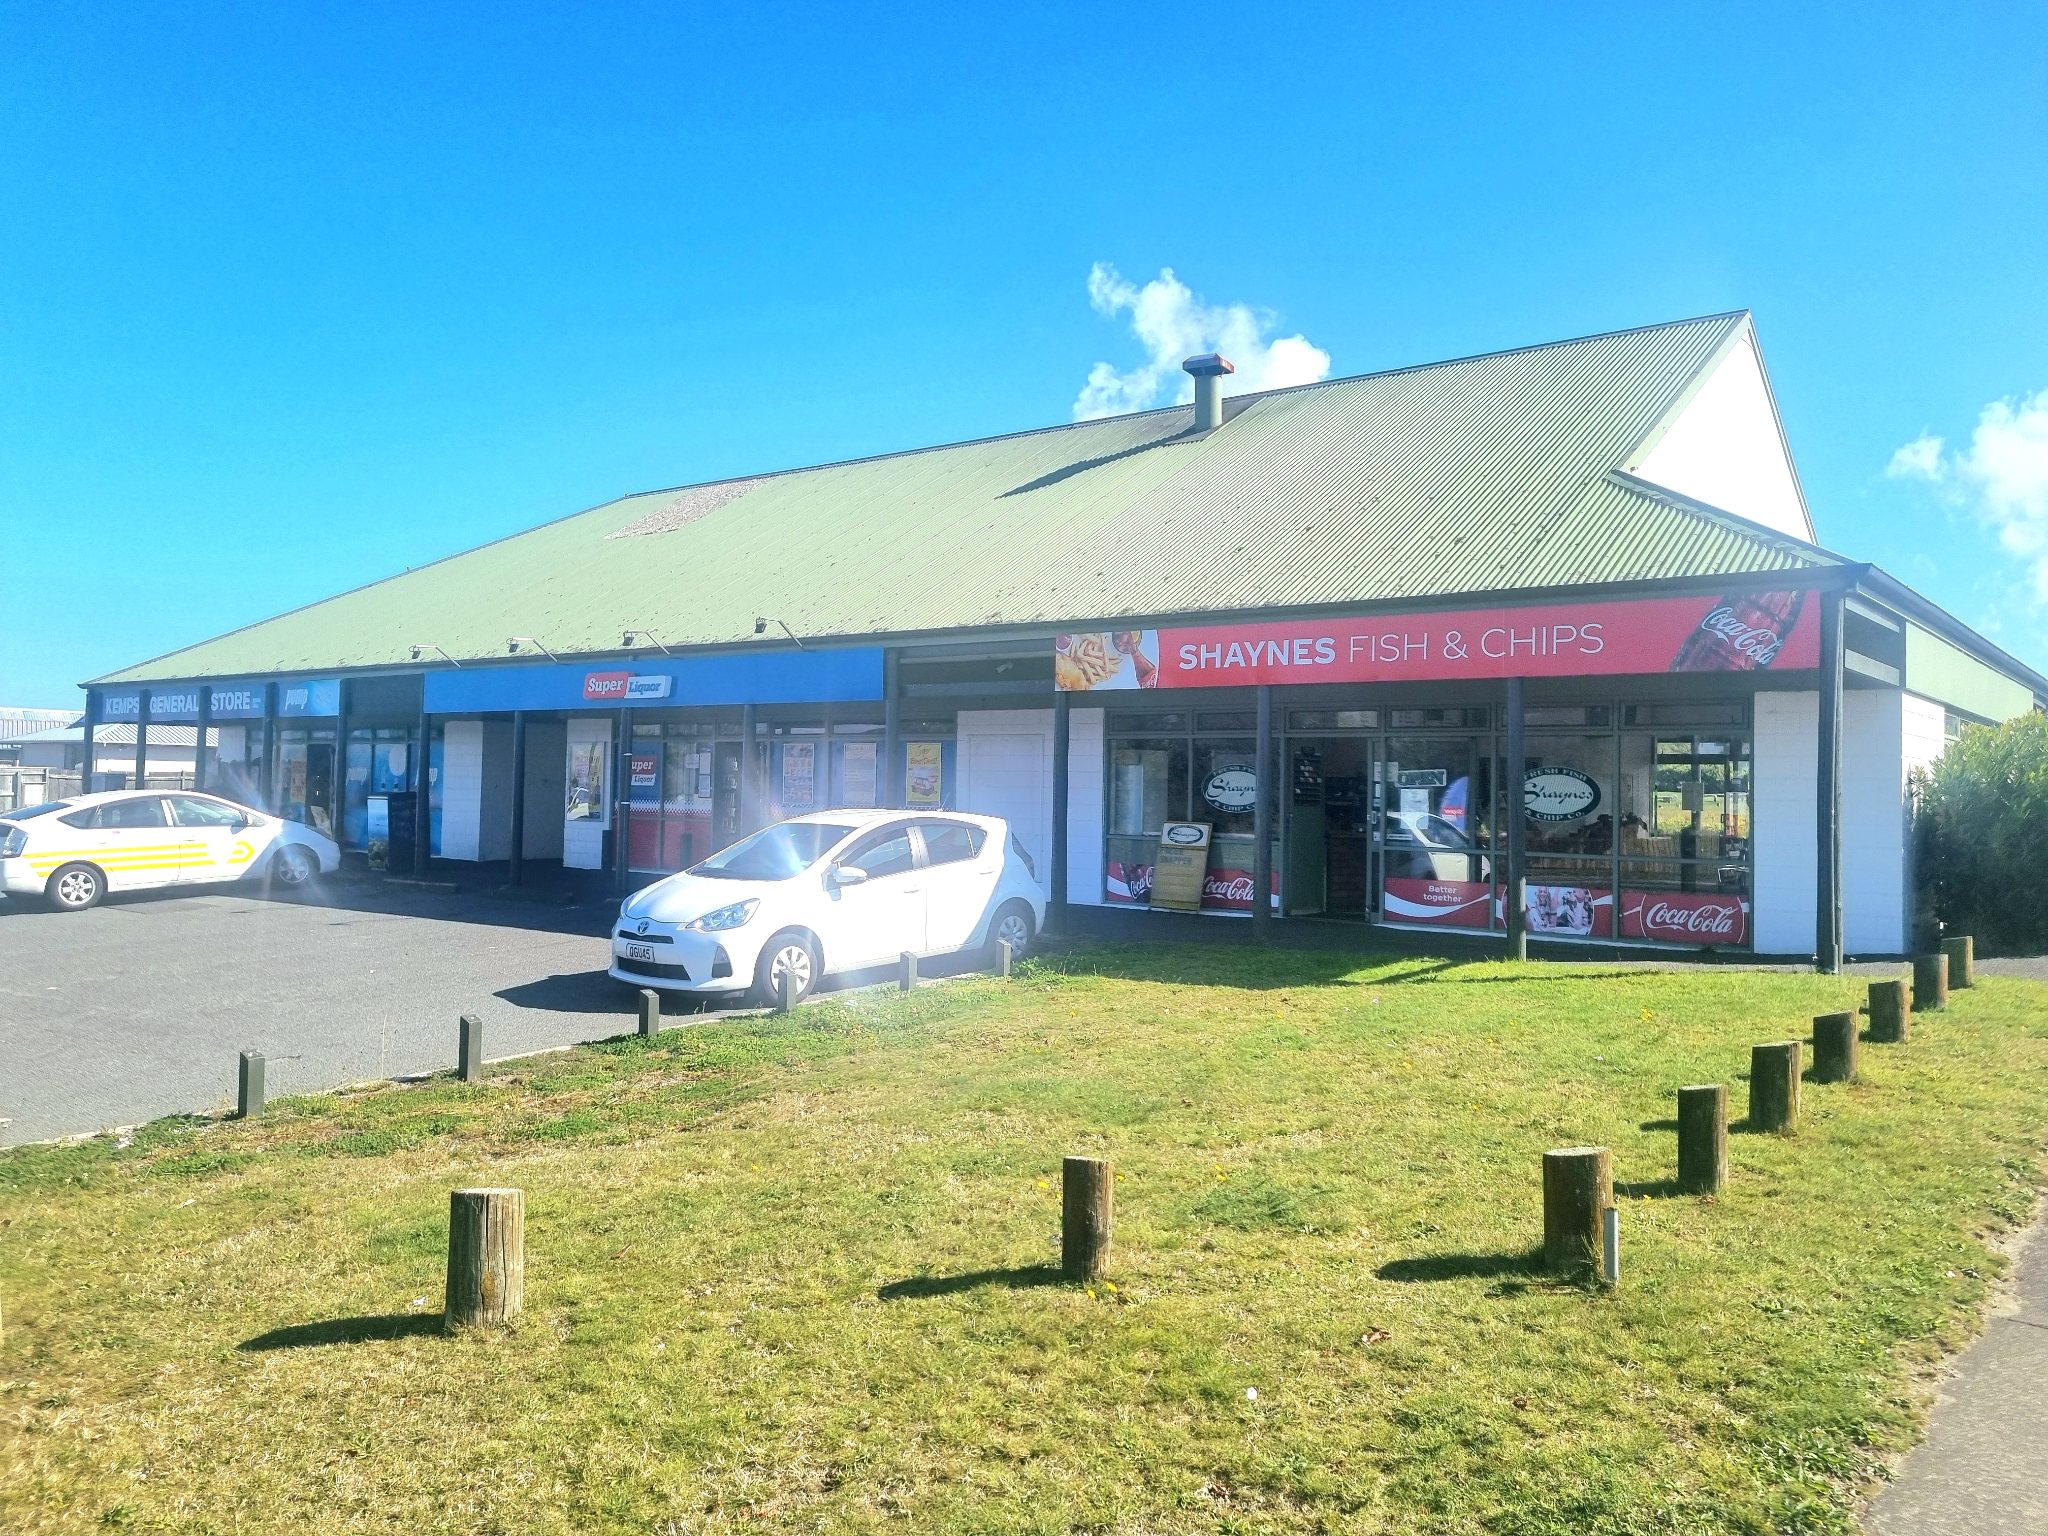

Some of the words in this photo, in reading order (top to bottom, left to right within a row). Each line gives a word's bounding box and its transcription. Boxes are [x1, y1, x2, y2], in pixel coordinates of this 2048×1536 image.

[1702, 607, 1782, 664] Coca-Cola
[1178, 637, 1336, 670] SHAYNES
[1349, 631, 1428, 663] FISH
[1442, 630, 1469, 659] &
[1481, 623, 1604, 658] CHIPS
[588, 678, 623, 694] Super
[628, 682, 661, 695] Liquor
[105, 696, 140, 714] KEMPS
[149, 695, 199, 713] GENERAL
[211, 692, 251, 711] STORE
[631, 761, 653, 772] uper
[1423, 893, 1462, 902] together
[1428, 885, 1457, 894] Better
[1646, 902, 1735, 934] Coca-Cola
